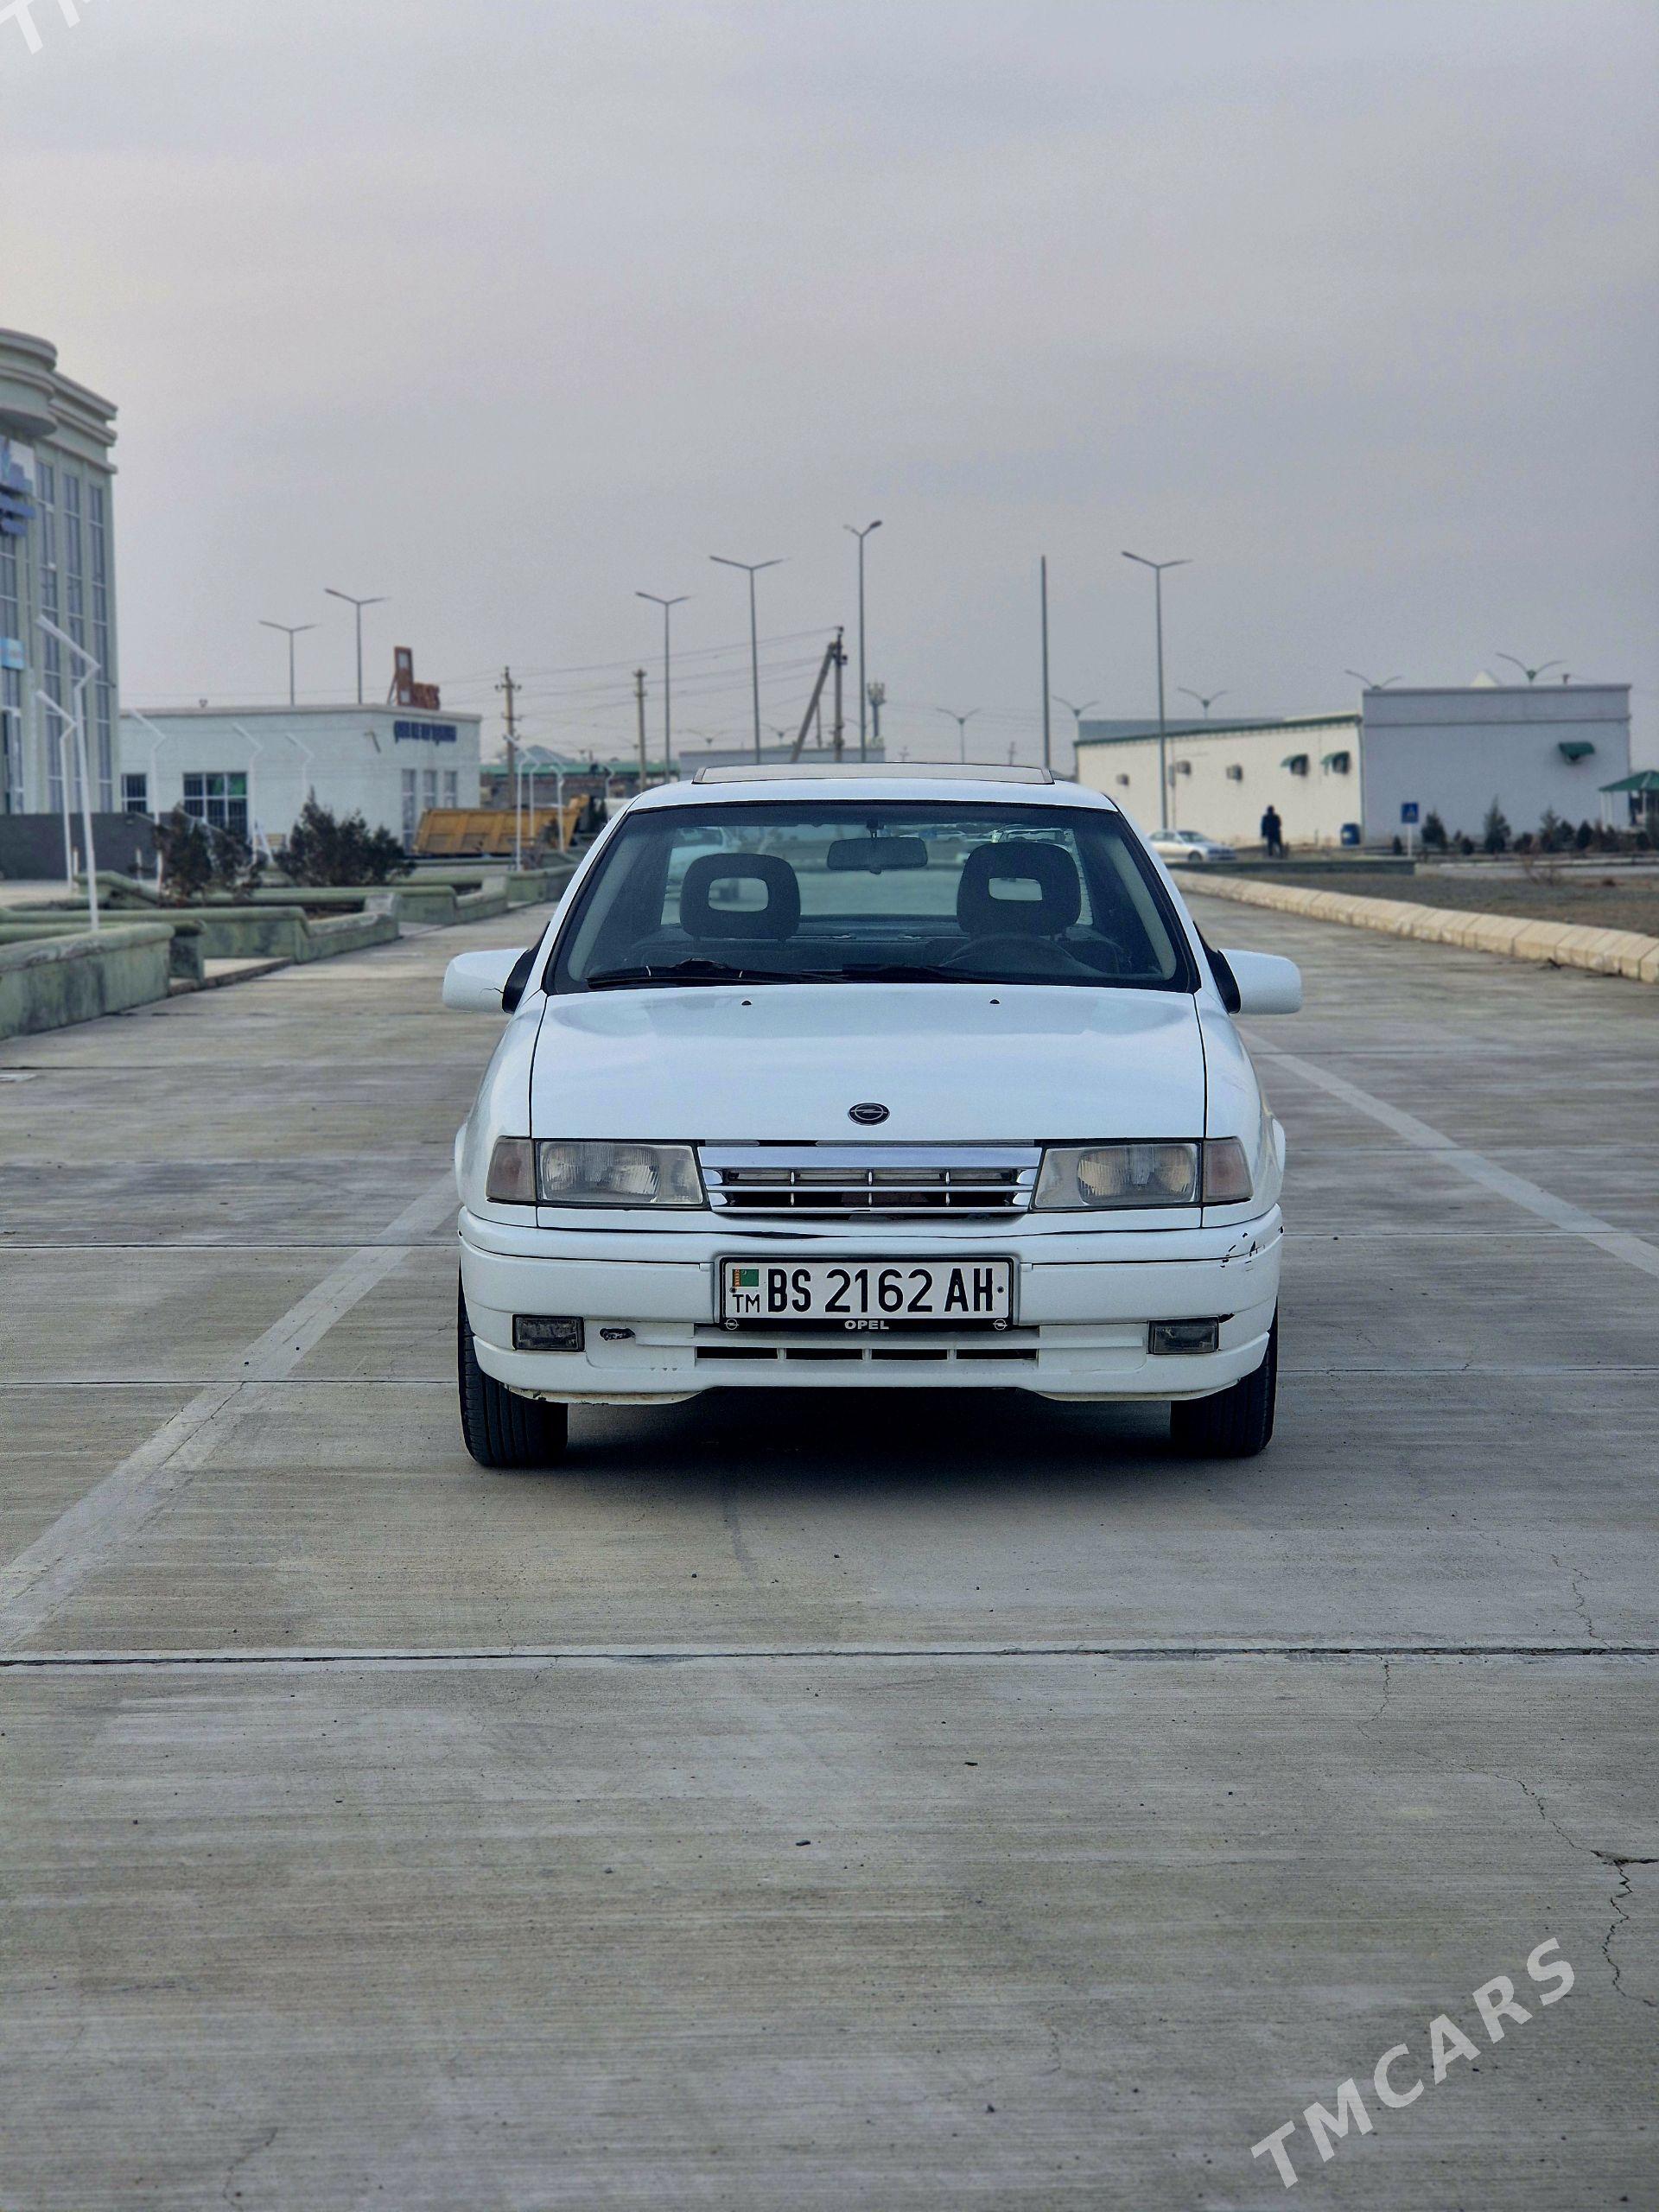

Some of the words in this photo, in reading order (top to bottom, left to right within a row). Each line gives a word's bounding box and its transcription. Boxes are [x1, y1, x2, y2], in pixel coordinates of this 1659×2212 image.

[767, 1268, 811, 1313] BS
[824, 1268, 933, 1313] 2162
[944, 1268, 993, 1312] AH
[732, 1294, 760, 1313] TM
[843, 1319, 889, 1330] OPEL
